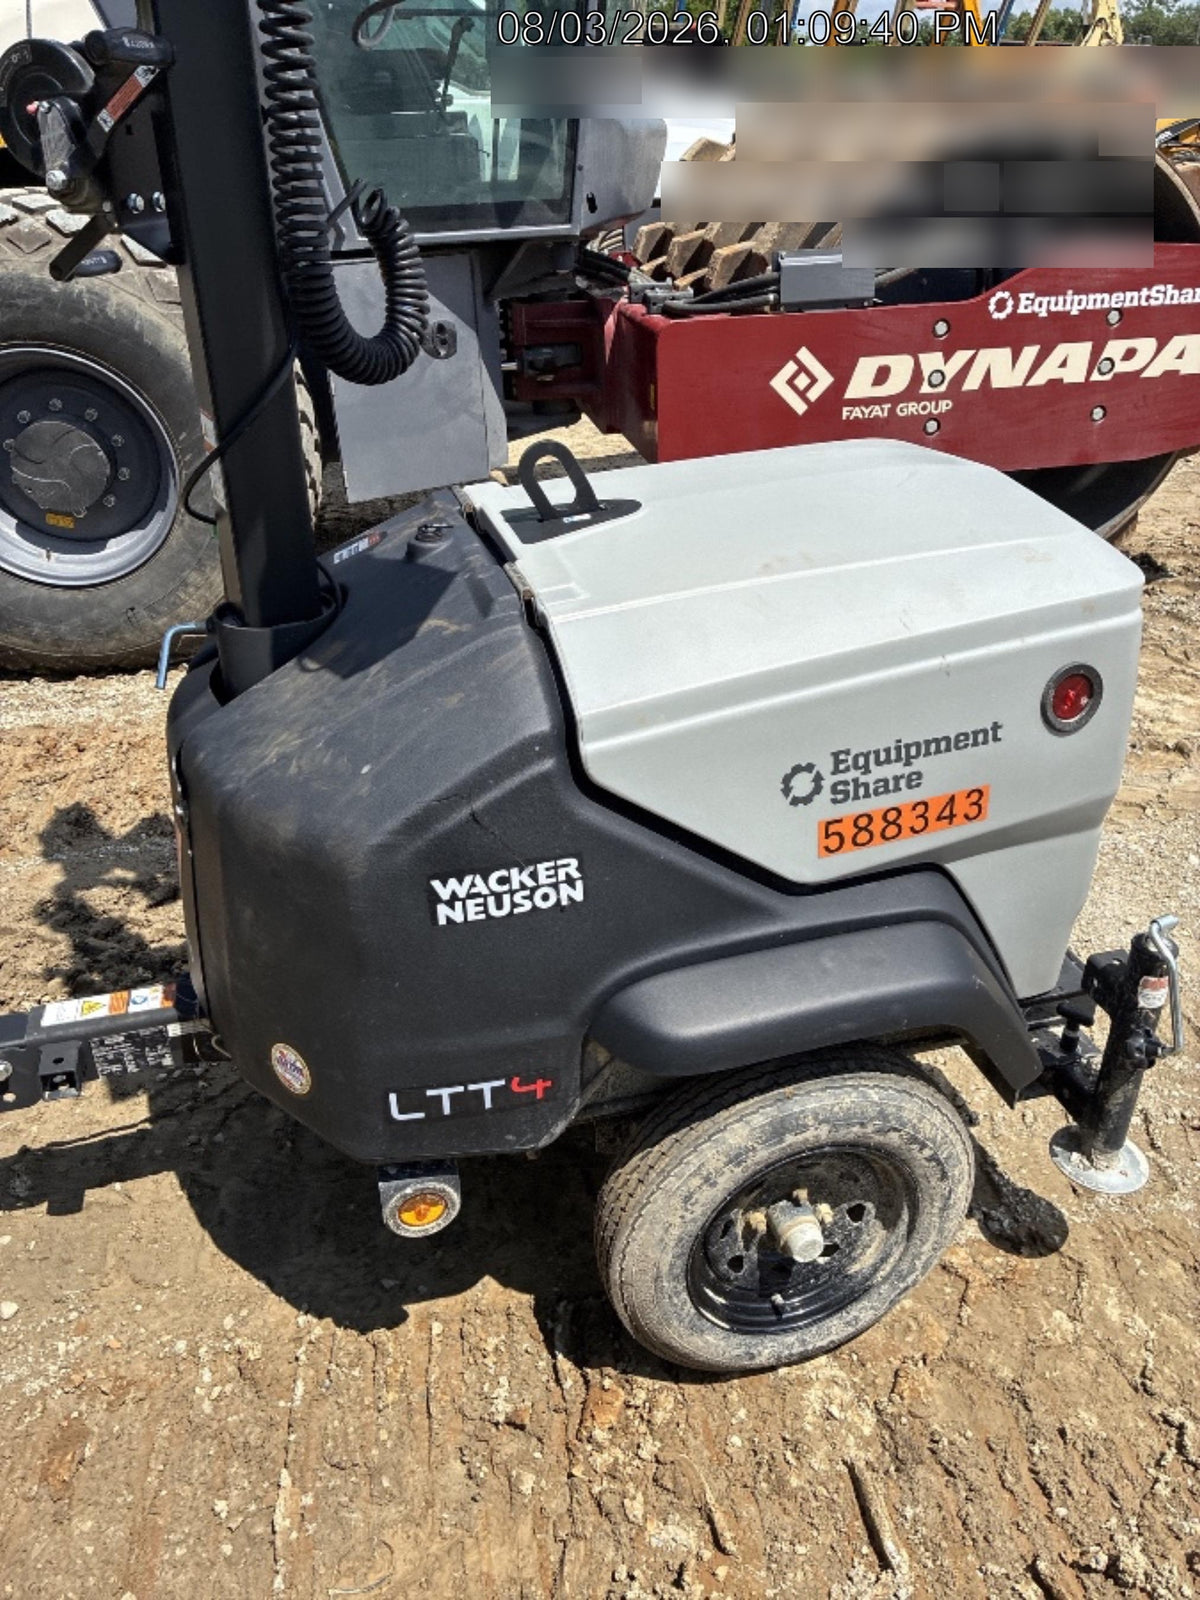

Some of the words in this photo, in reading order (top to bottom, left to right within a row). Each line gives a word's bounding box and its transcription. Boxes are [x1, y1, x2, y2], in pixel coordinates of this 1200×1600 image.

[843, 333, 1200, 399] DYNAPA
[842, 403, 892, 421] FAYAT
[896, 400, 953, 418] GROUP
[830, 721, 1003, 776] Equipment
[829, 770, 923, 805] Share
[823, 788, 984, 854] 588343
[429, 857, 582, 901] WACKER
[436, 879, 584, 926] NEUSON
[388, 1076, 552, 1121] LTT4
